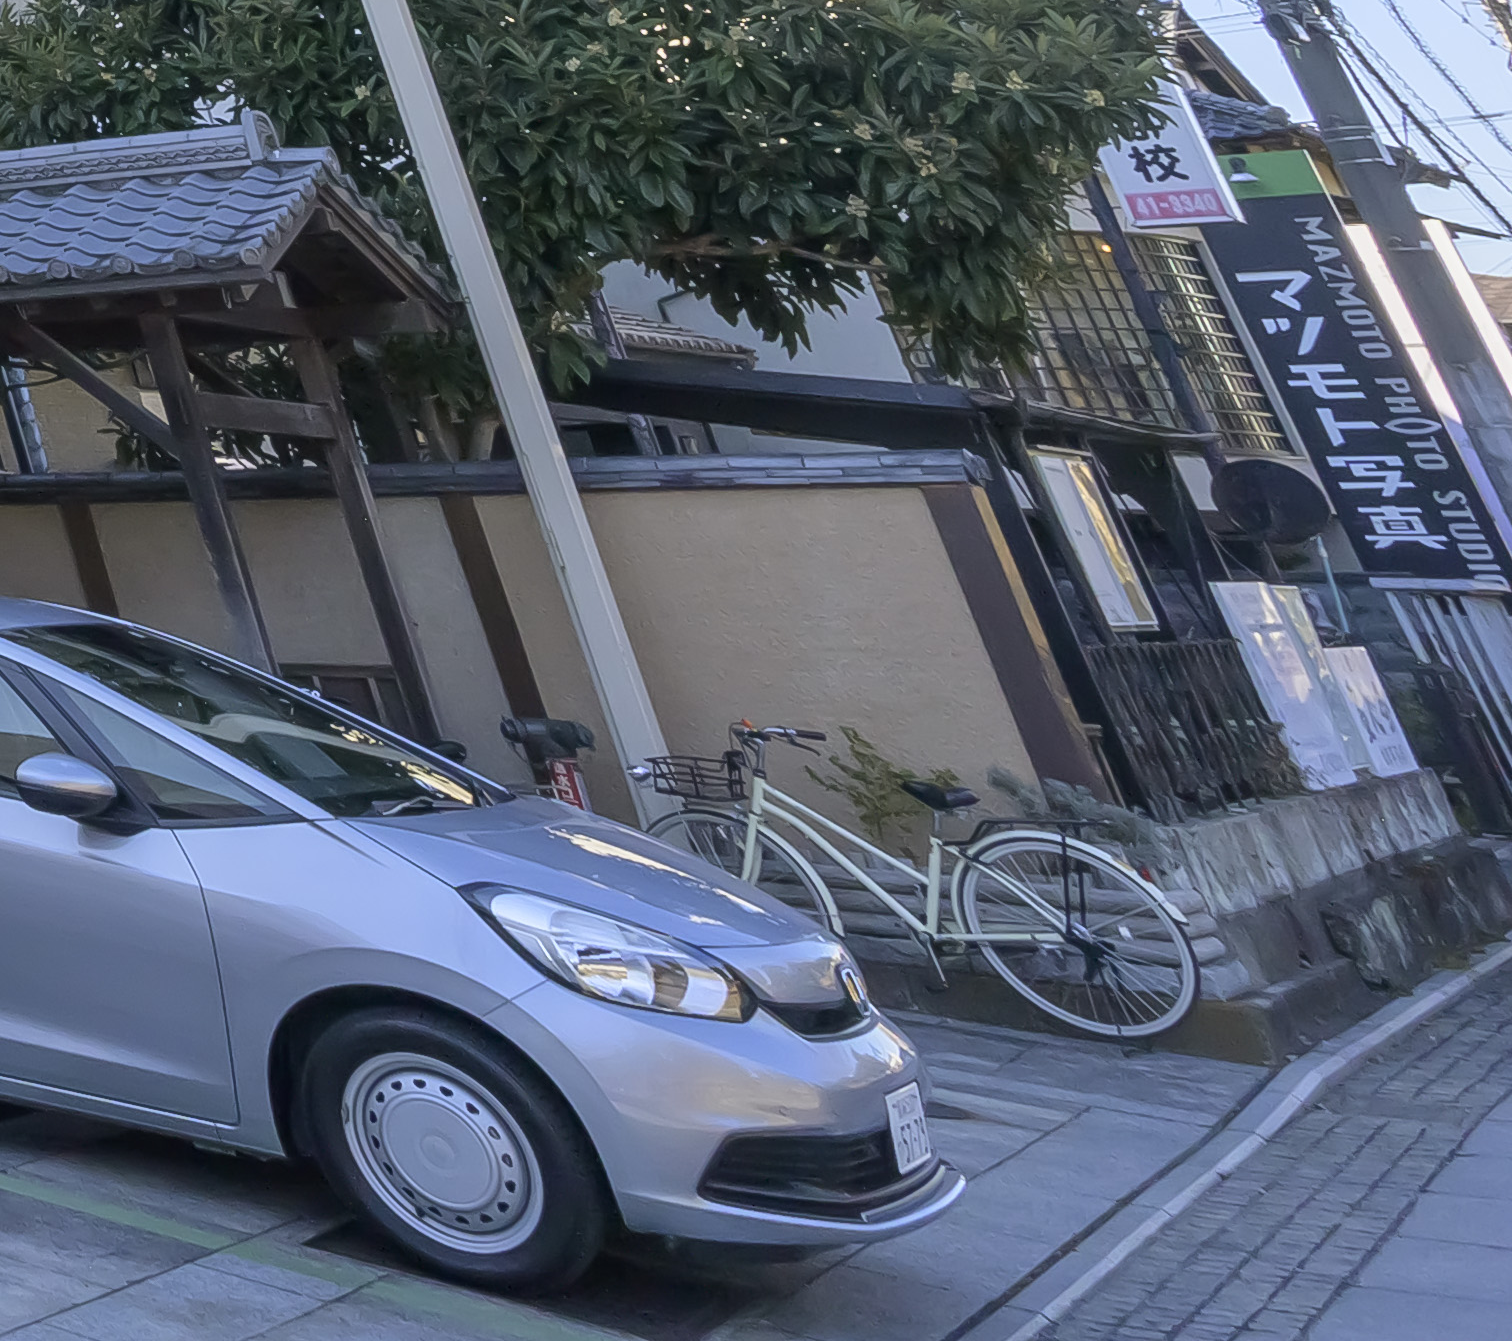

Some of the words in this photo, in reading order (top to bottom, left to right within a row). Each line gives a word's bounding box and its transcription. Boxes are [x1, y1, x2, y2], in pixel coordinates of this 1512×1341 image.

[1235, 269, 1449, 551] マツモト写真
[1293, 216, 1393, 361] MAZMOTO
[1374, 377, 1450, 471] PHOTO
